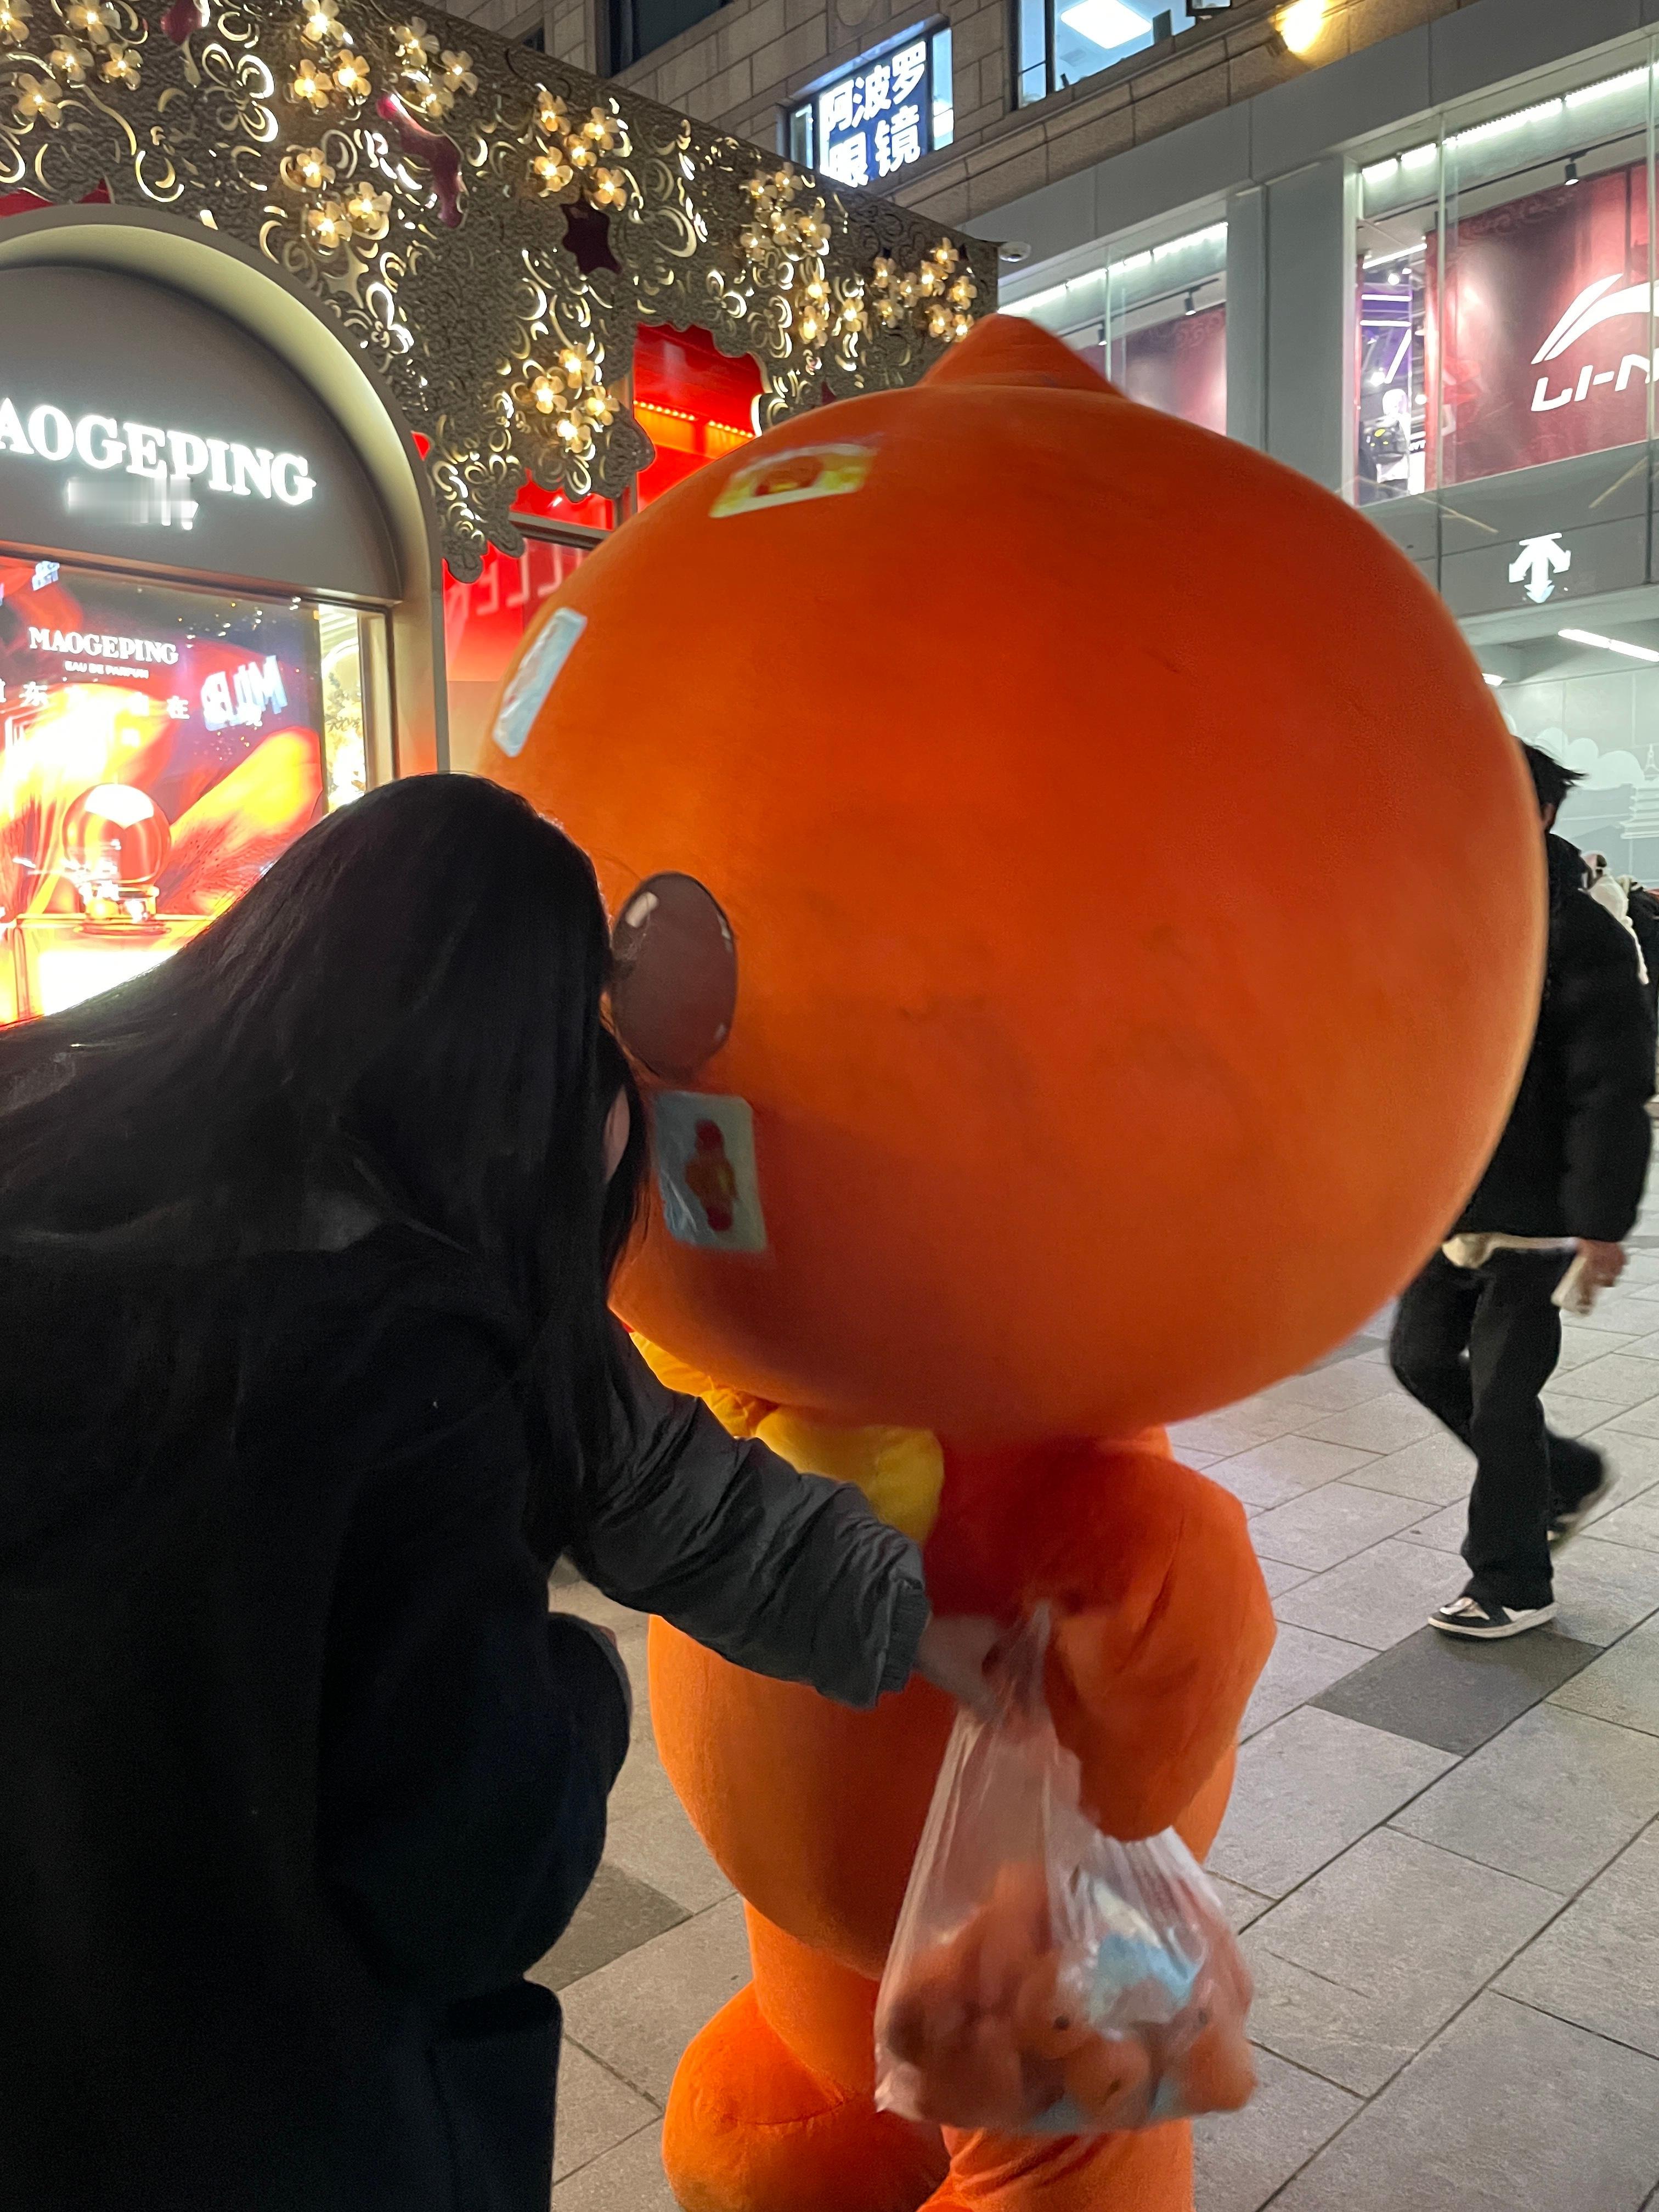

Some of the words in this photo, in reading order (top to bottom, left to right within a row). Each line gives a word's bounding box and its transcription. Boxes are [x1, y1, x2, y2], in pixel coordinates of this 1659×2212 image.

[820, 40, 927, 133] 阿波罗
[827, 104, 921, 188] 眼镜
[28, 627, 179, 665] MAOGEPING
